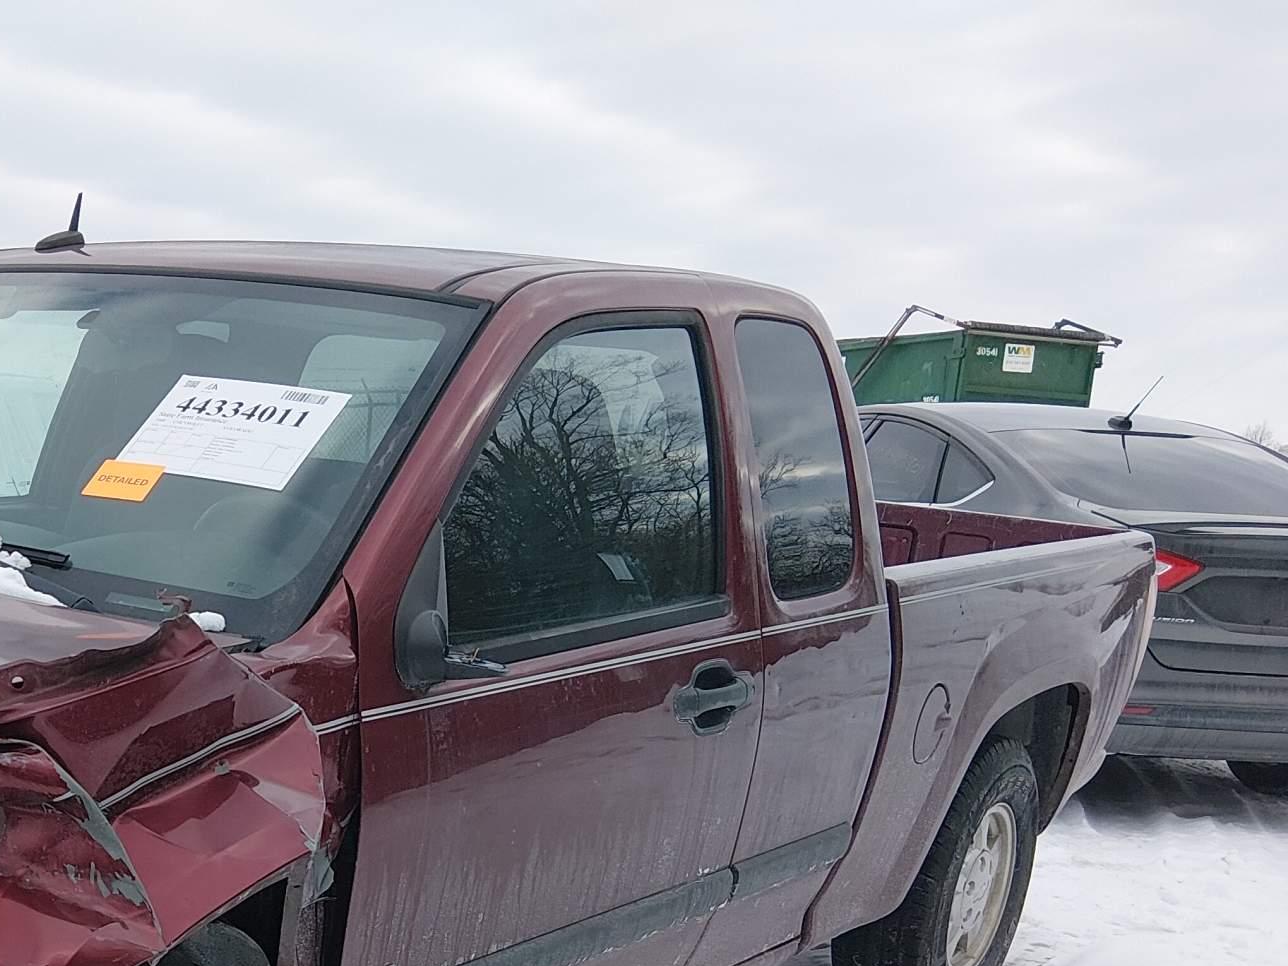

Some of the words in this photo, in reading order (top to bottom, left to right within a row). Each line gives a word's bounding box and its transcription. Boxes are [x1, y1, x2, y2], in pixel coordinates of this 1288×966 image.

[1007, 346, 1032, 355] WM
[176, 396, 310, 428] 44334011
[98, 475, 149, 487] DETAILED
